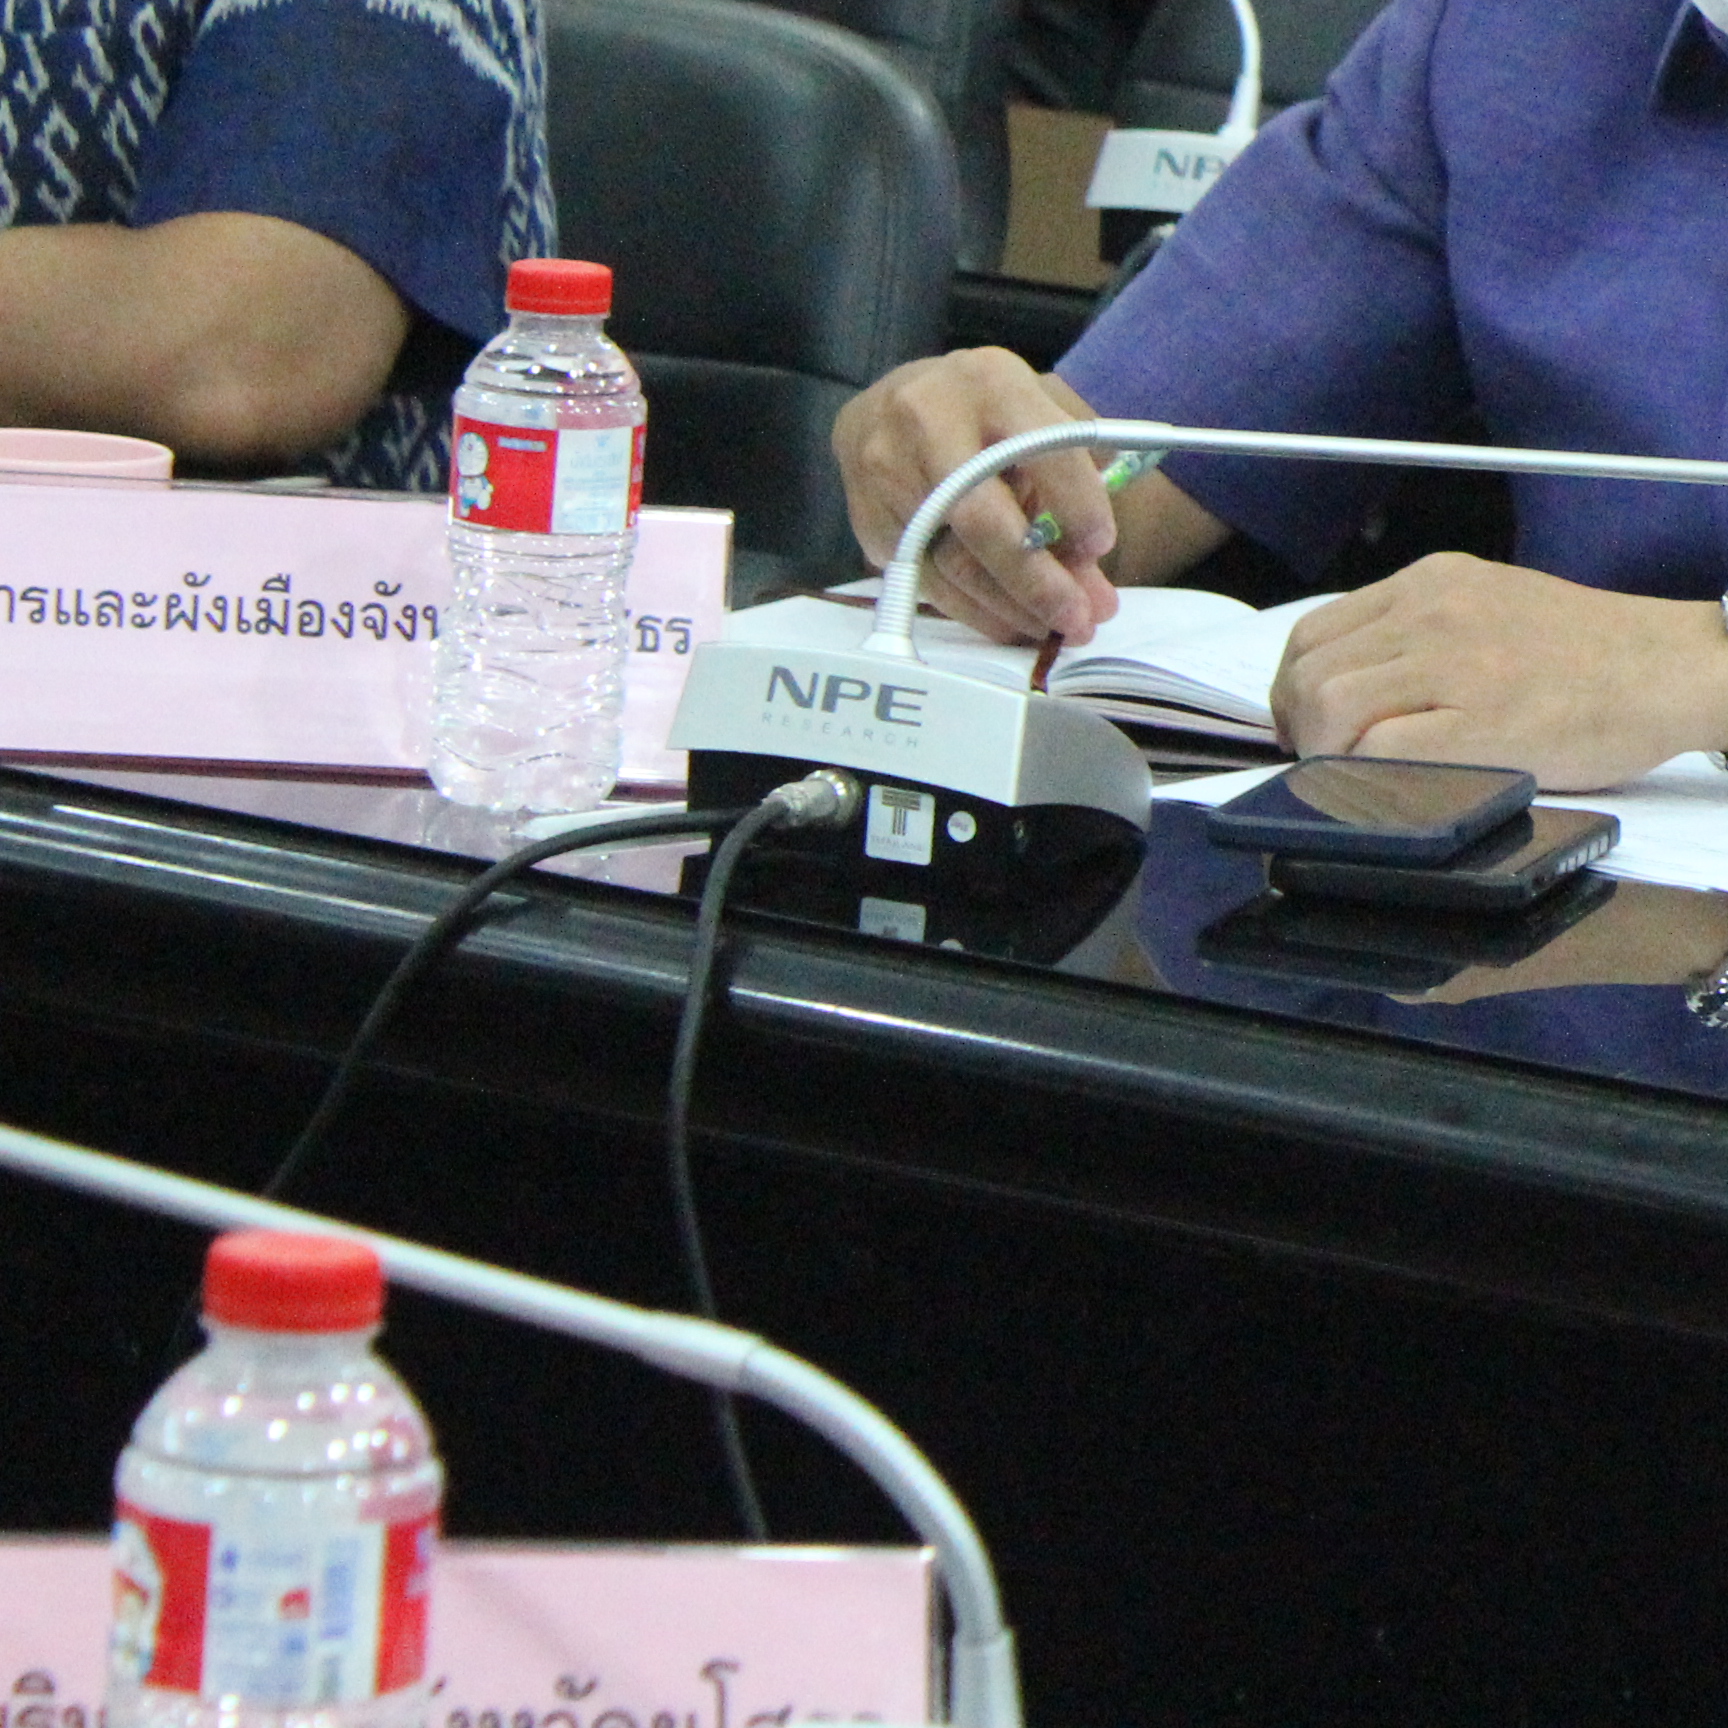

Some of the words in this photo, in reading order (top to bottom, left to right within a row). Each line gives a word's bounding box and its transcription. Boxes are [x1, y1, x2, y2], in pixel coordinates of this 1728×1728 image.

[1153, 148, 1229, 181] NP
[766, 665, 928, 727] NPE
[761, 711, 919, 748] RESEARCH
